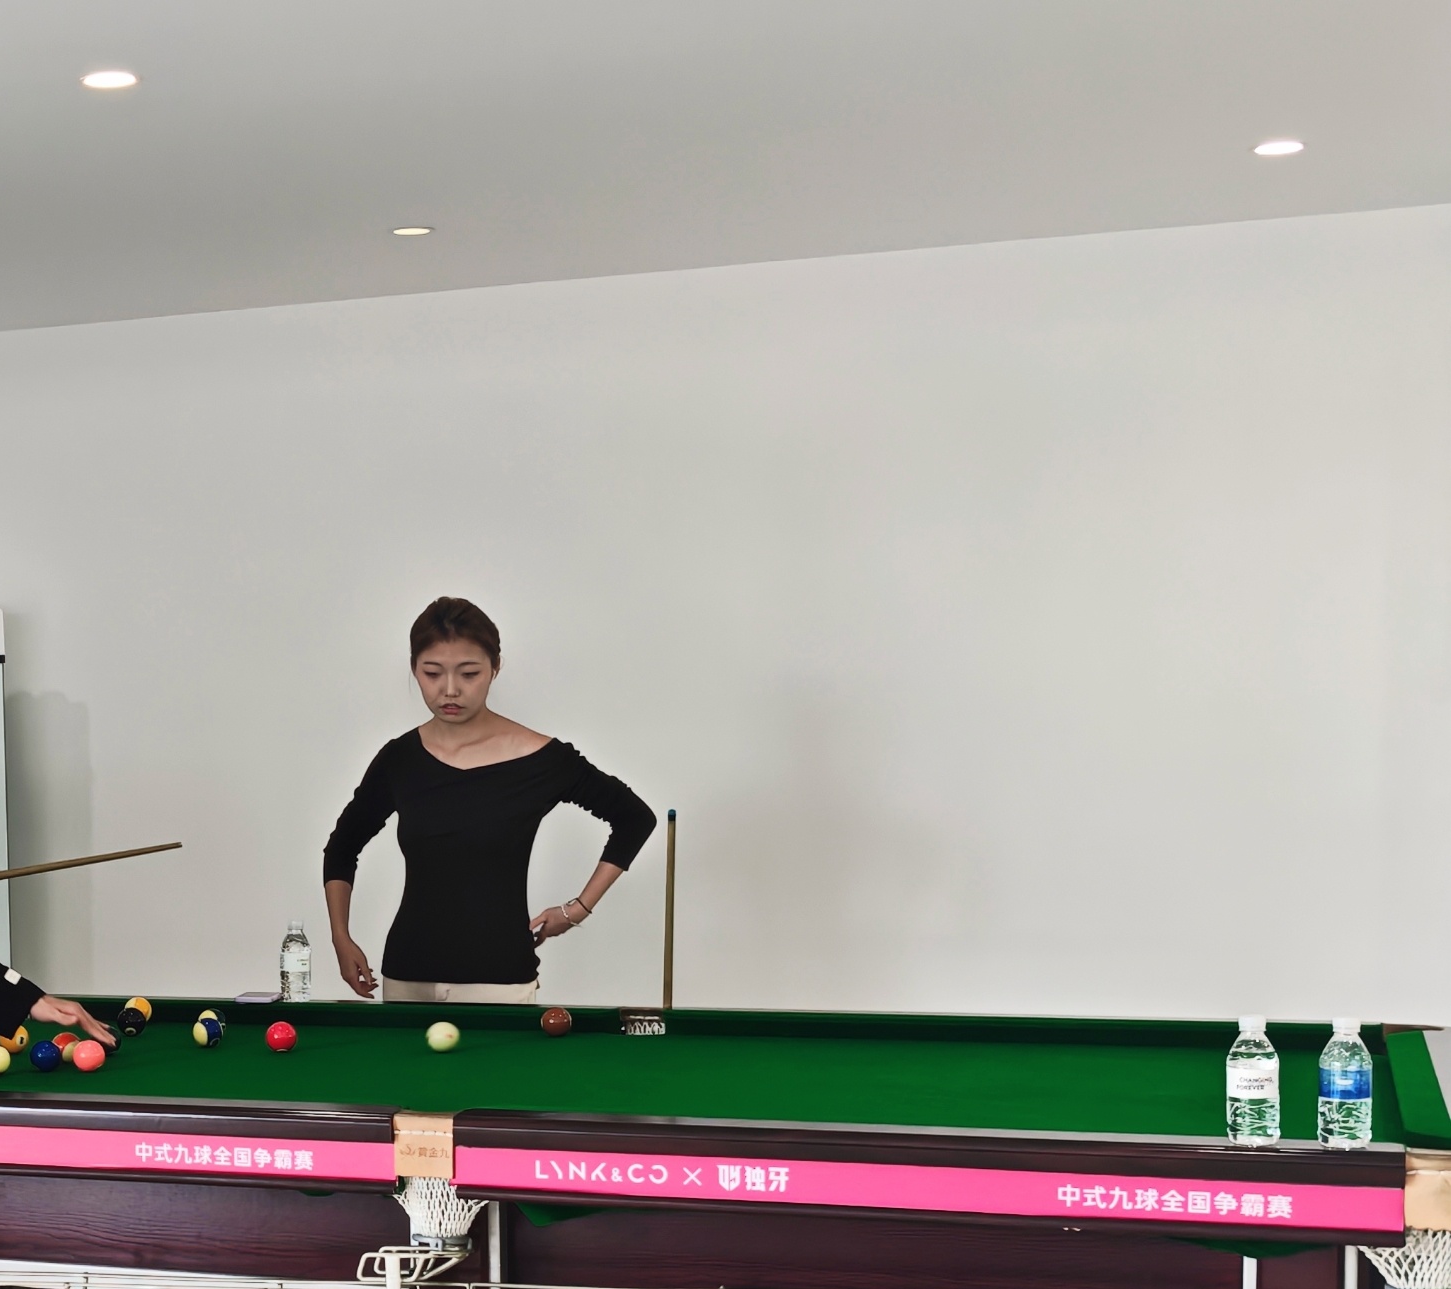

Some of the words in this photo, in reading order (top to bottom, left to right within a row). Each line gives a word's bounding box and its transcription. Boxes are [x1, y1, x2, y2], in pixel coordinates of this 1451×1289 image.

[135, 1142, 314, 1171] 中式九球全国争霸赛
[535, 1160, 668, 1185] LYNK&CO
[1057, 1184, 1293, 1219] 中式九球全国争霸赛
